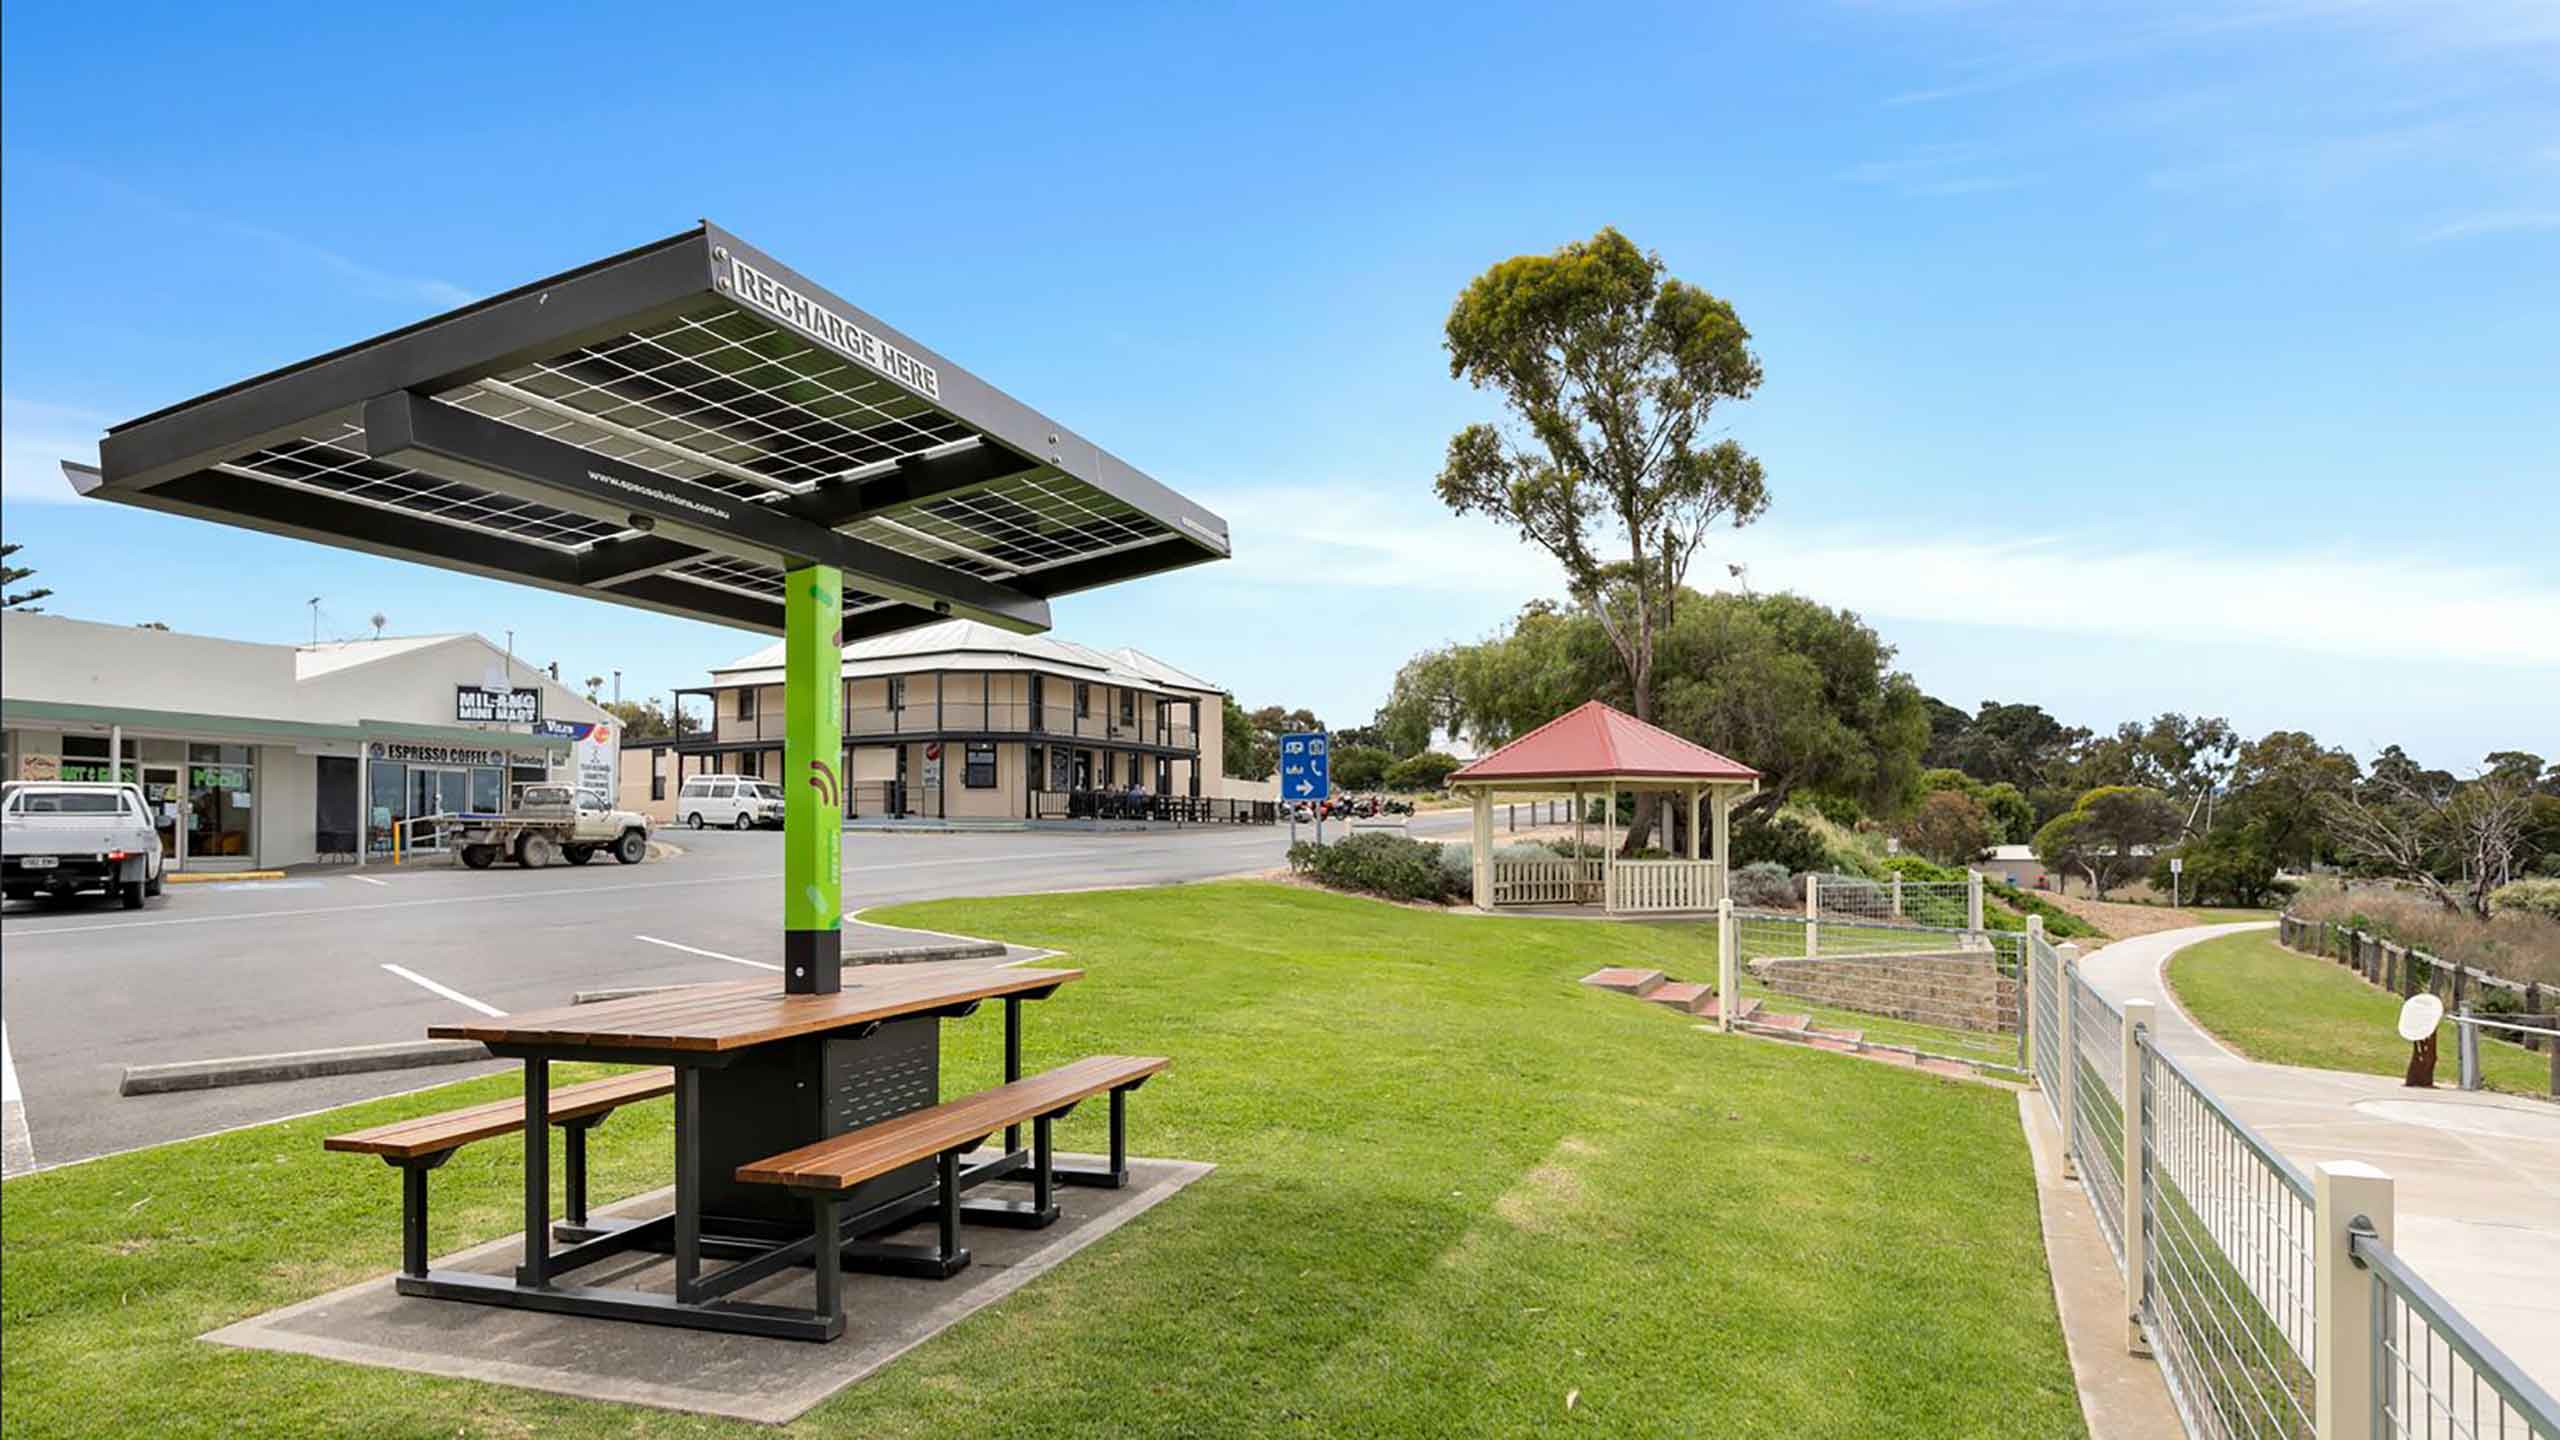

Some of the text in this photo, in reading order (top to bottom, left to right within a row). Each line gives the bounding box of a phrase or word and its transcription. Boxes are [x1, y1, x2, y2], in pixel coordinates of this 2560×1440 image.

[738, 263, 937, 397] RECHARGE HERE
[459, 707, 535, 722] MINI MART
[388, 743, 488, 764] ESPRESSO COFFEE
